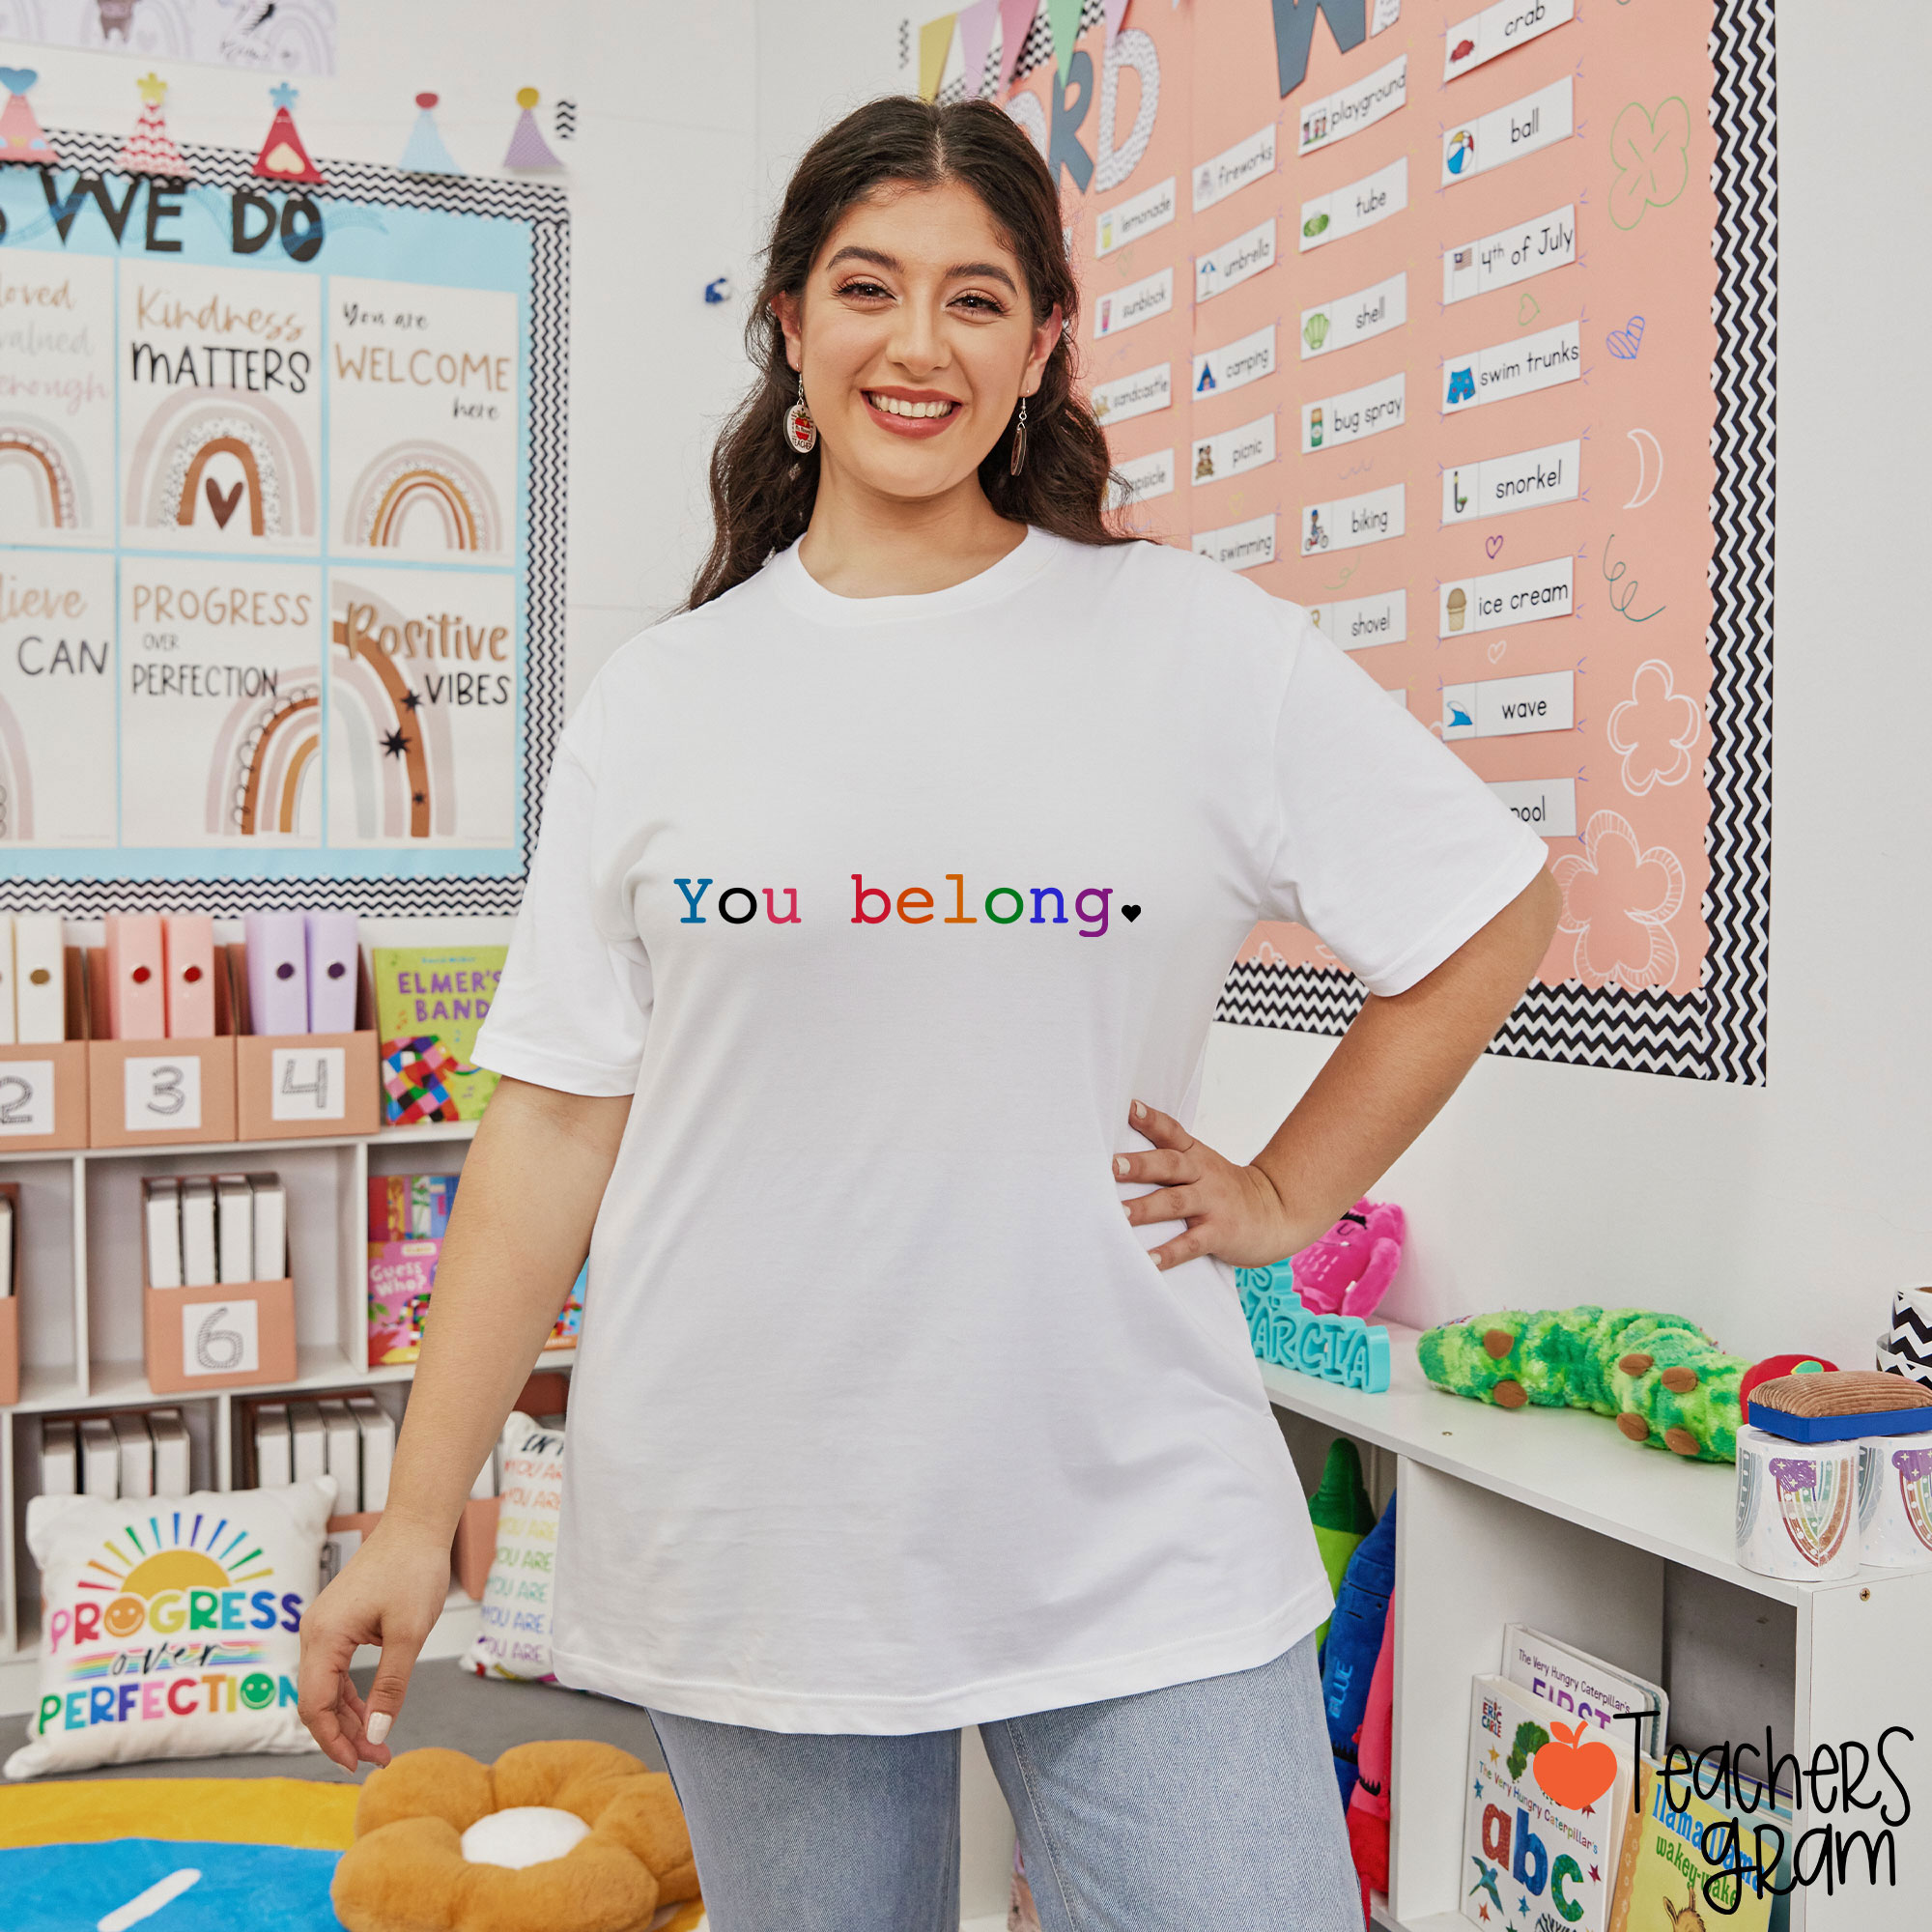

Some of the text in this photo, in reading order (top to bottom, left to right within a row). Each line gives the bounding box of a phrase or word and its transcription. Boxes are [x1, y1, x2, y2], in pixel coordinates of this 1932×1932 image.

[1504, 0, 1546, 36] crab
[1330, 64, 1406, 131] playground
[1511, 107, 1540, 144] ball
[1218, 138, 1273, 186] fireworks
[40, 171, 188, 252] WE
[232, 188, 325, 262] DO
[1121, 193, 1172, 233] lemonade
[1356, 188, 1387, 217] tube
[1224, 240, 1270, 278] umbrella
[1482, 222, 1574, 273] 4th of July
[136, 286, 306, 341] Kindness
[343, 302, 429, 330] You are
[1122, 284, 1167, 320] sunblock
[1356, 296, 1386, 329] shell
[132, 342, 311, 393] MATTERS
[335, 343, 511, 391] WELCOME
[1226, 349, 1269, 378] camping
[1480, 341, 1580, 386] swim trunks
[453, 397, 500, 421] here
[1114, 375, 1169, 408] sandcastle
[1334, 397, 1403, 433] bug spray
[1233, 440, 1263, 468] picnic
[1496, 459, 1562, 498] snorkel
[1352, 508, 1388, 533] biking
[1220, 534, 1273, 562] swimming
[133, 584, 312, 627] PROGRESS
[1478, 583, 1569, 616] ice cream
[344, 602, 509, 661] Positive
[1352, 606, 1391, 637] shovel
[18, 636, 108, 675] CAN
[143, 633, 180, 651] OVER
[132, 664, 278, 698] PERFECTION
[425, 672, 511, 706] VIBES
[1502, 698, 1548, 720] wave
[673, 873, 1114, 938] You belong
[415, 999, 492, 1022] BAND
[0, 1076, 34, 1123] 2
[147, 1065, 185, 1115] 3
[282, 1058, 328, 1110] 4
[370, 1262, 422, 1283] Guess
[375, 1273, 427, 1297] Who?
[197, 1306, 243, 1369] 6
[1248, 1306, 1370, 1387] ARCIA
[50, 1591, 302, 1654] PROGRESS
[513, 1610, 546, 1634] ARE
[112, 1641, 240, 1675] over
[1328, 1661, 1353, 1719] BLUE
[1520, 1648, 1631, 1714] The Very Hungry Caterpillar's
[1482, 1715, 1501, 1738] CARLE
[1483, 1701, 1502, 1724] ERIC
[1480, 1760, 1598, 1855] The Very Hungry Caterpillar's
[1482, 1804, 1584, 1922] abc
